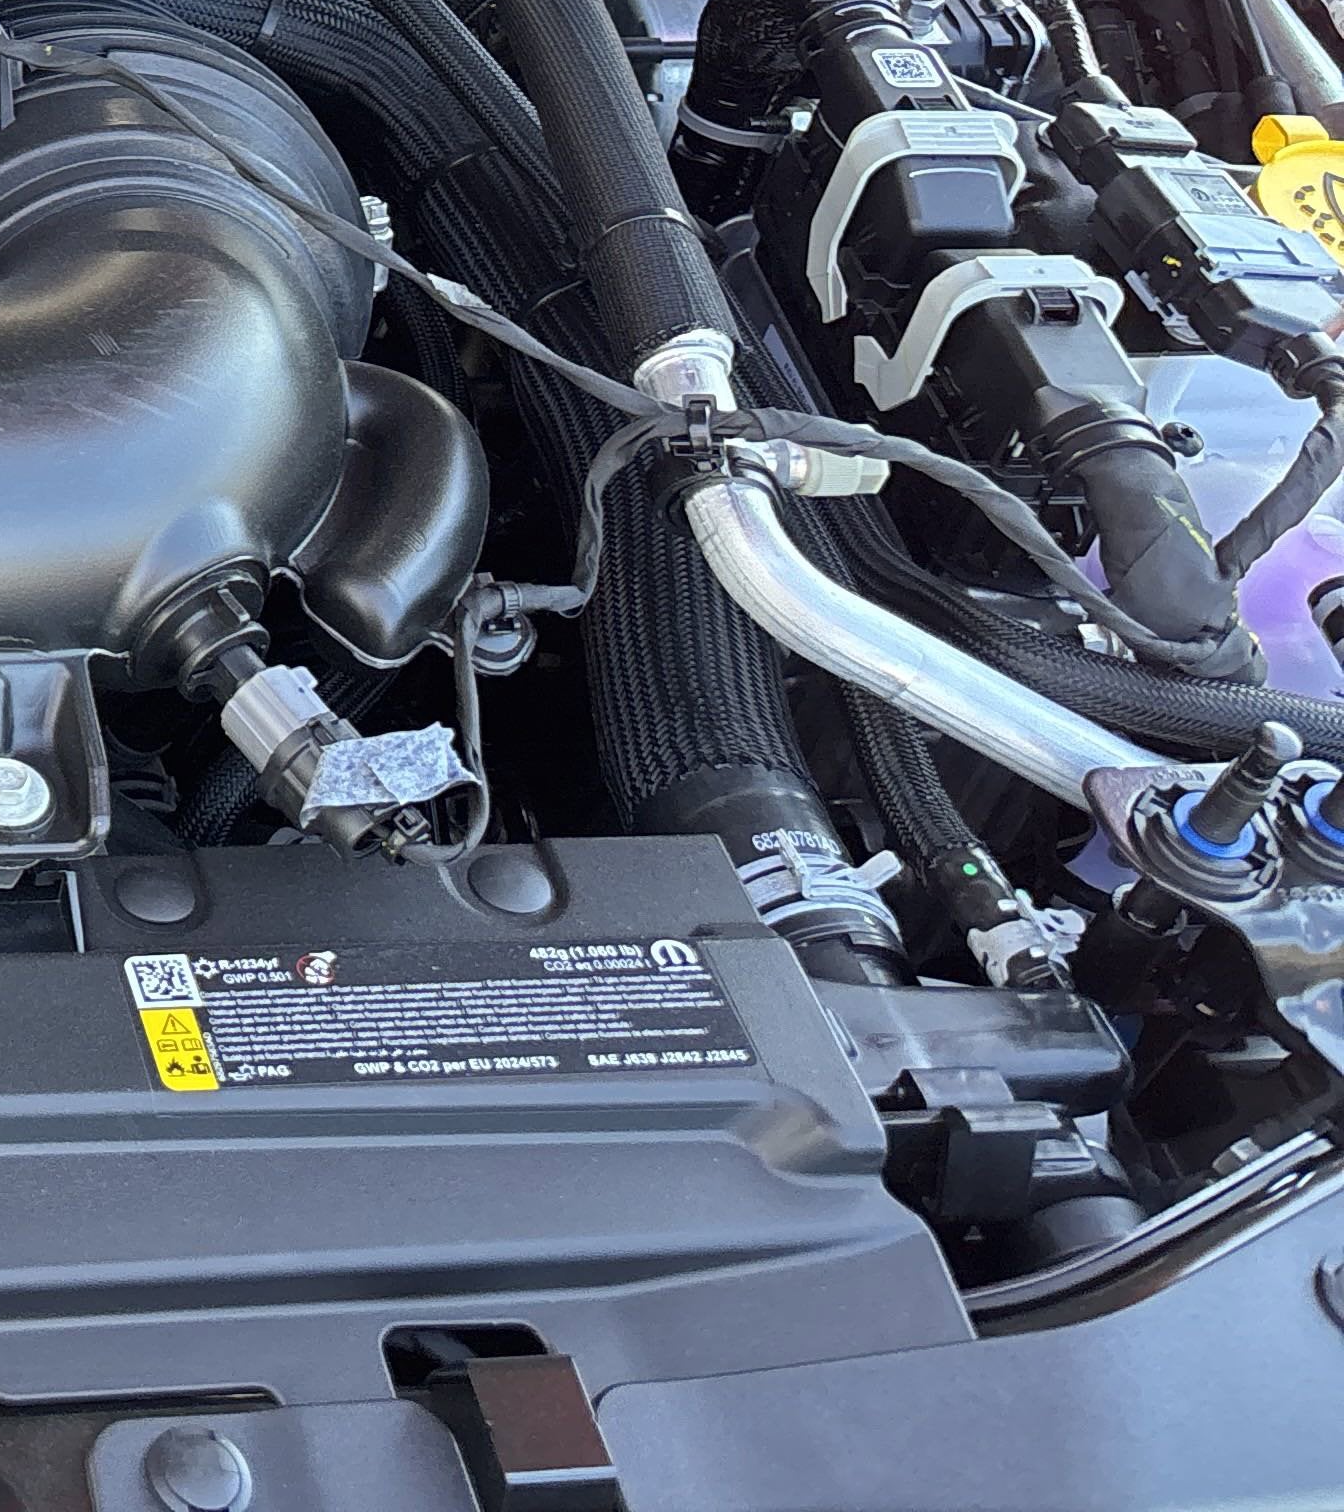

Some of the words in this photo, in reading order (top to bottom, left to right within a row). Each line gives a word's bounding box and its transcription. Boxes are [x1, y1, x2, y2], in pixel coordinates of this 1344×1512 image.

[752, 830, 841, 855] 6820781AD
[218, 957, 279, 970] R-1234yf
[544, 960, 573, 971] CO2
[223, 972, 256, 984] GWP
[353, 1061, 390, 1075] GWP
[393, 1061, 406, 1073] &
[408, 1060, 439, 1073] CO2
[442, 1061, 466, 1075] per
[468, 1058, 492, 1070] EU
[587, 1053, 620, 1067] SAE
[257, 1065, 291, 1077] PAG
